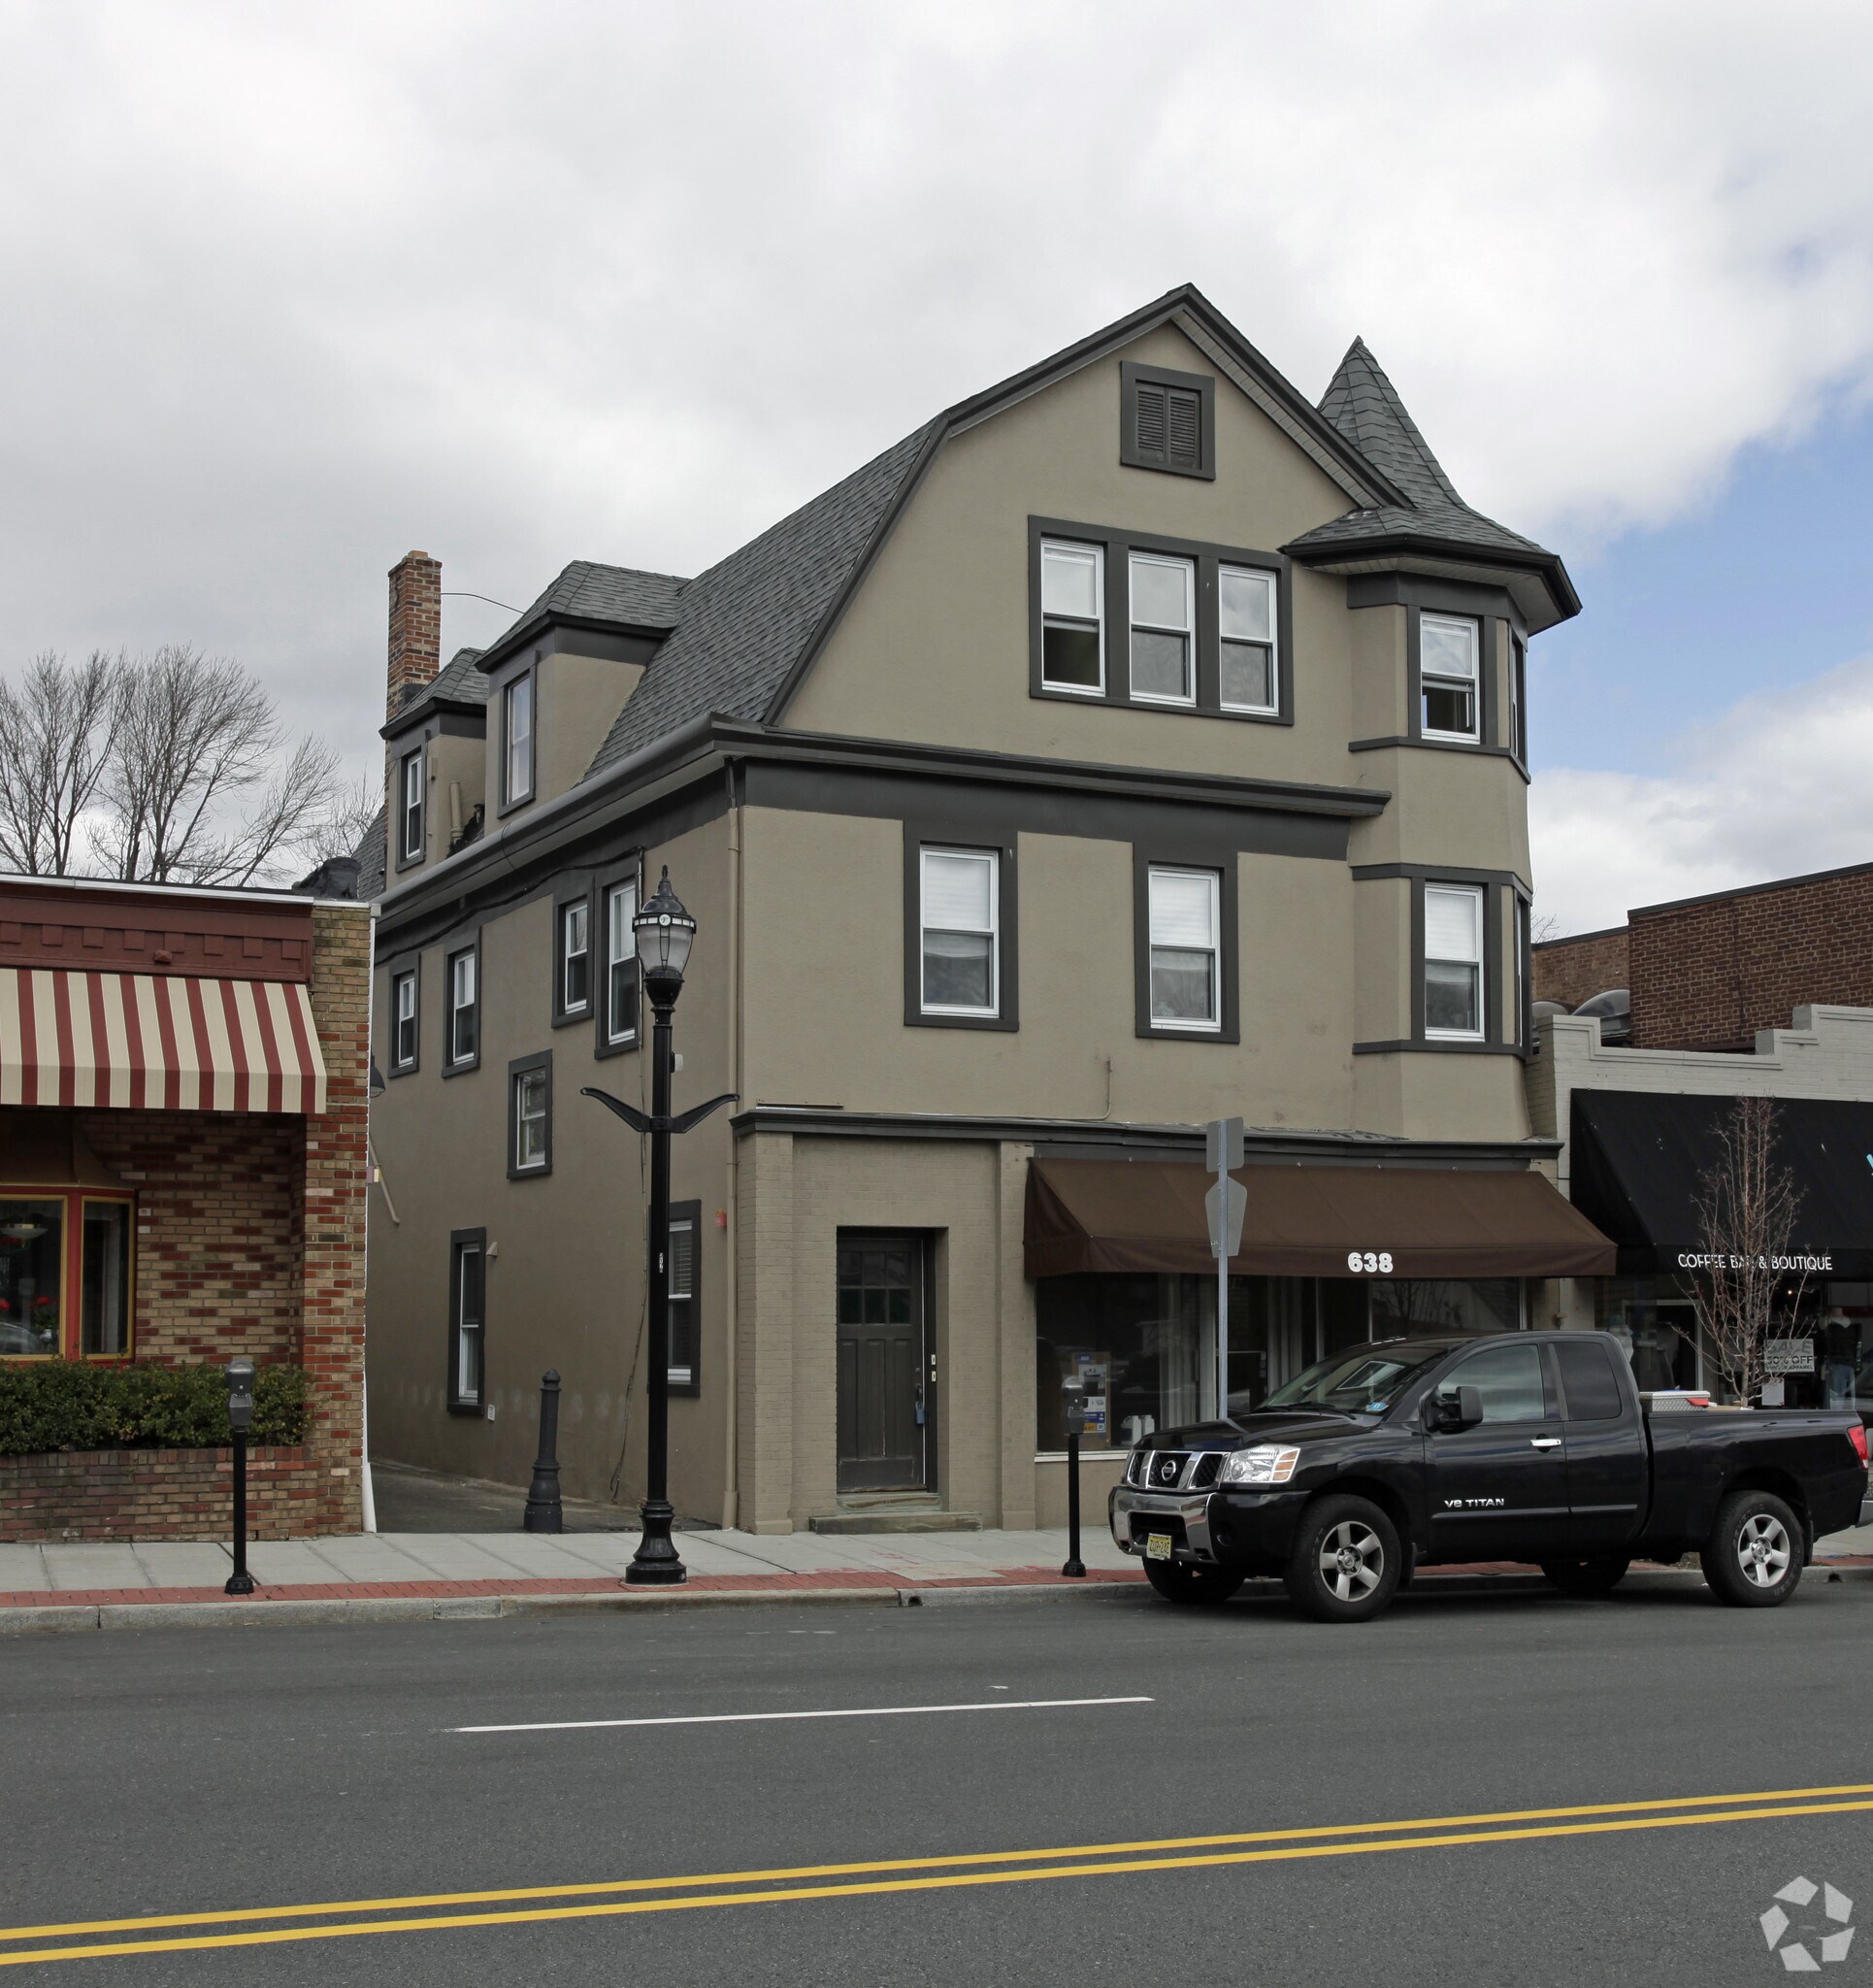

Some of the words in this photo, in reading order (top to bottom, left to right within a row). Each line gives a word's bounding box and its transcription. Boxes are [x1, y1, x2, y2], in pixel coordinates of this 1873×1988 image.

[1347, 1251, 1394, 1274] 638
[1678, 1253, 1726, 1269] COFFEE
[1771, 1255, 1833, 1271] BOUTIQUE
[1791, 1355, 1813, 1365] OFF
[1444, 1499, 1462, 1508] V8
[1465, 1498, 1504, 1508] TITAN
